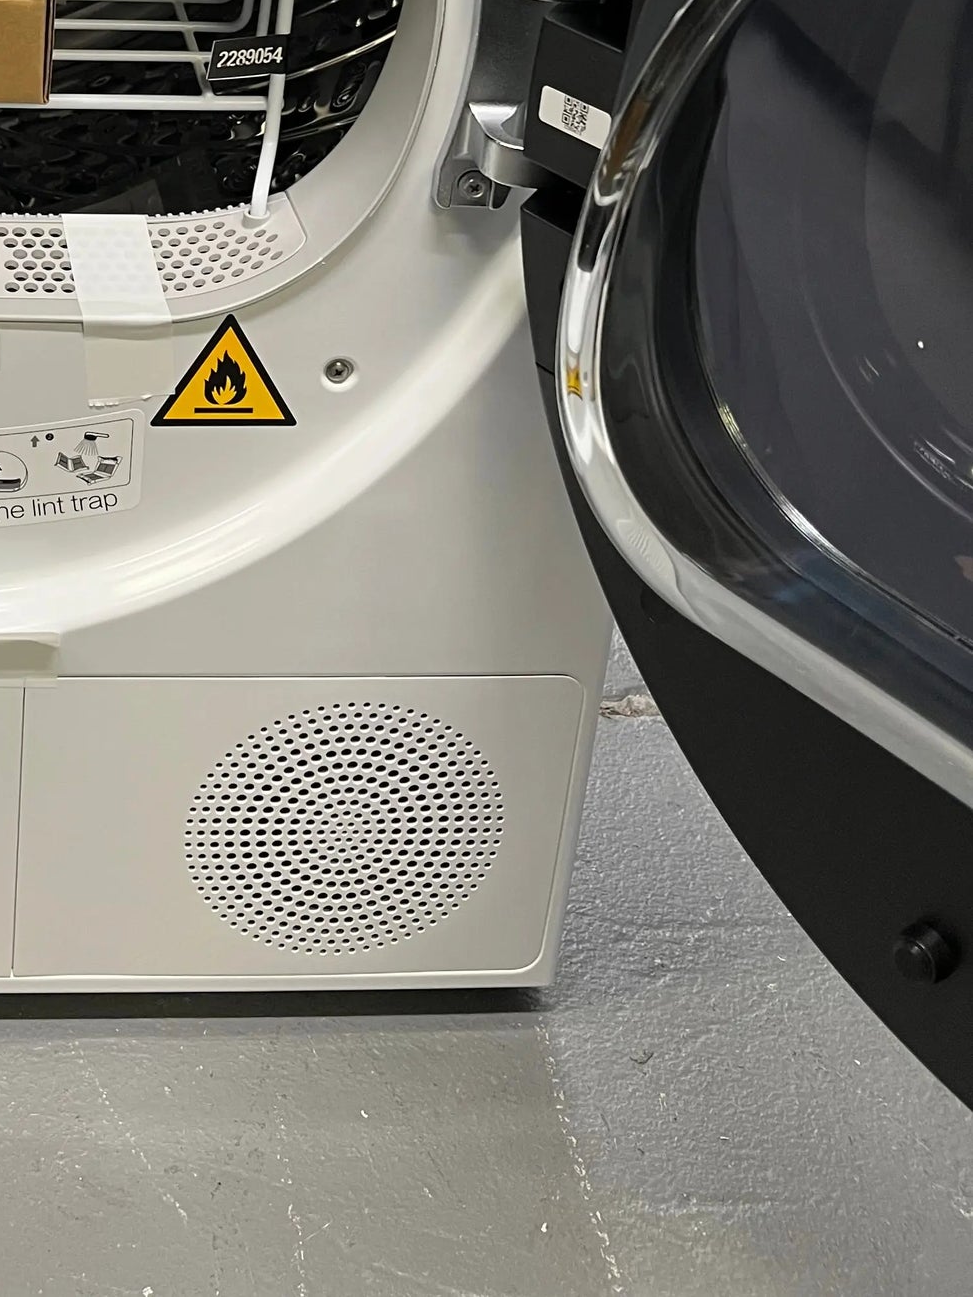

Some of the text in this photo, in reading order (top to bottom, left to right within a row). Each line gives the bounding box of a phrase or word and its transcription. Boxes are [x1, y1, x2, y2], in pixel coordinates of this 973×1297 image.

[216, 46, 284, 68] 2289054
[32, 496, 65, 517] lint
[70, 492, 118, 513] trap
